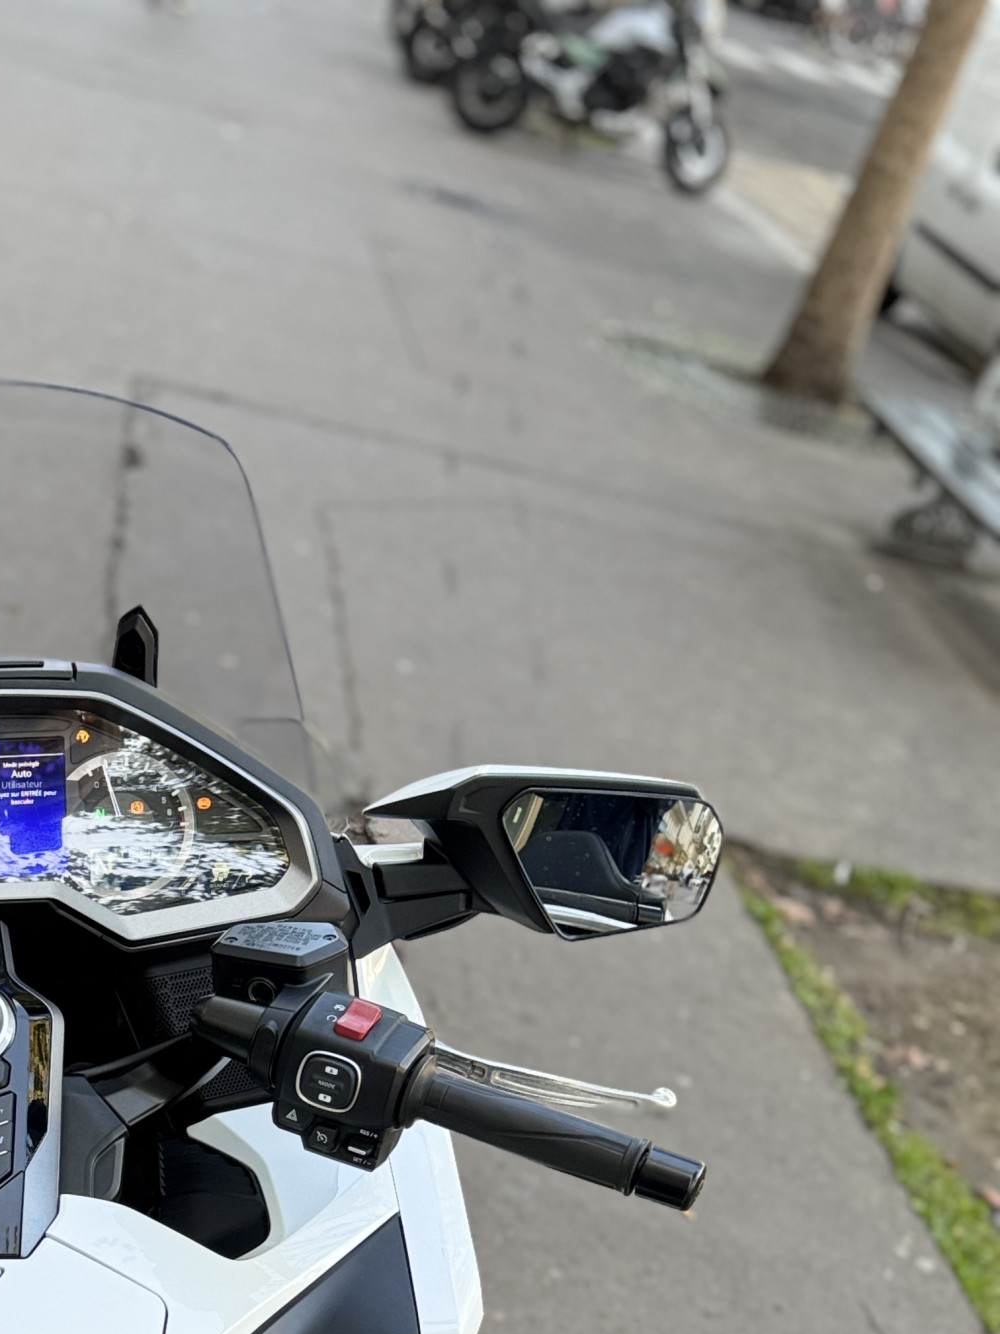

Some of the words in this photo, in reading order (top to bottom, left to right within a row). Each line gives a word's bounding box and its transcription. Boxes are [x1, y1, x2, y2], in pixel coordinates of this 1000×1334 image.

[11, 770, 32, 778] Auto
[1, 781, 43, 789] Utilisateur
[21, 789, 42, 797] ENTRÉE
